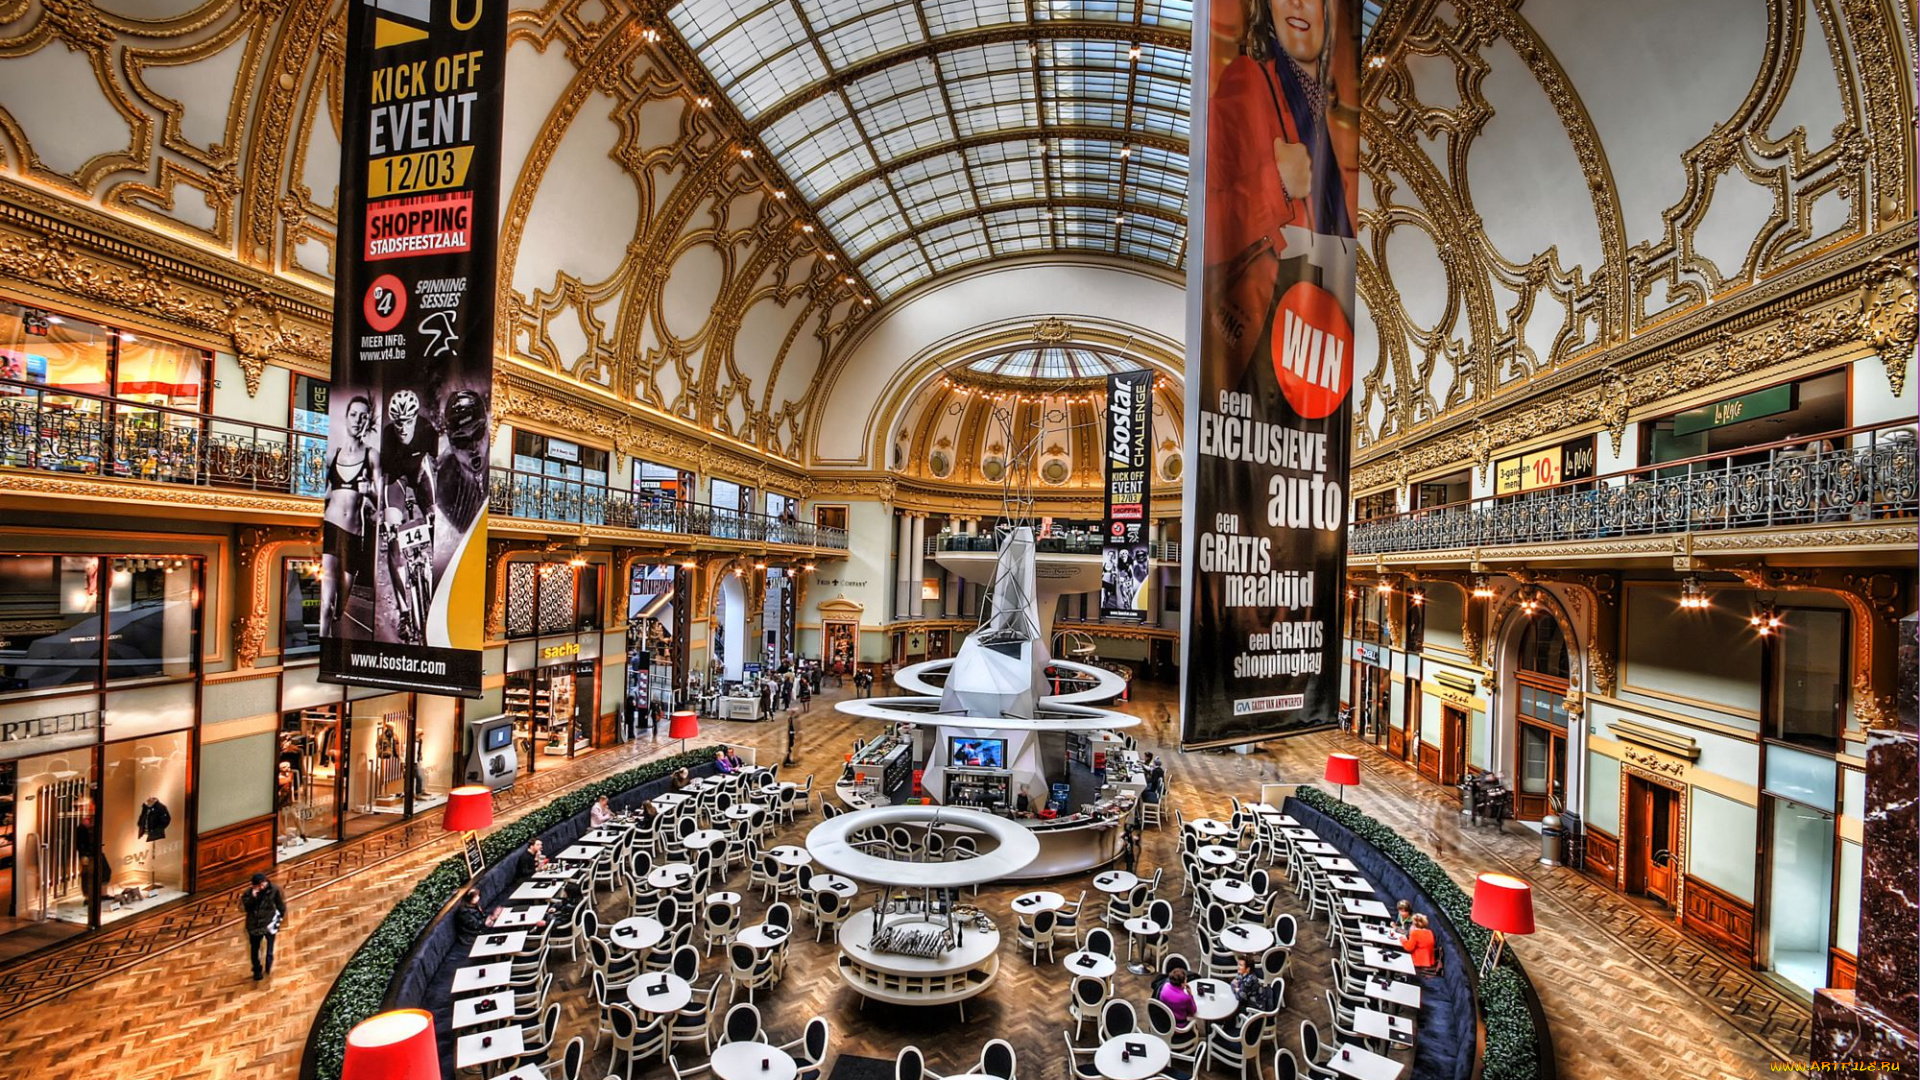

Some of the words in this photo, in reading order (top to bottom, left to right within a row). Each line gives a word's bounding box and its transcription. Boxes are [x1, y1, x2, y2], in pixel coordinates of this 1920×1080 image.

[372, 60, 427, 104] KICK
[434, 50, 483, 93] OFF
[370, 92, 478, 155] EVENT
[385, 151, 455, 192] 12/03
[371, 206, 467, 239] SHOPPING
[370, 231, 466, 255] STADSFEESTZAAL
[377, 292, 393, 314] 4
[420, 293, 461, 309] SESSIES
[360, 347, 406, 361] www.vt4.be
[361, 335, 383, 348] MEER
[385, 334, 406, 347] INFO:
[1282, 308, 1344, 394] WIN
[1219, 389, 1253, 418] een
[1108, 378, 1132, 464] isostar
[1134, 384, 1147, 468] CHALLENGE
[1200, 410, 1327, 472] EXCLUSIEVE
[1112, 472, 1129, 481] KICK
[1130, 471, 1145, 481] OFF
[1112, 481, 1143, 494] EVENT
[1117, 494, 1137, 503] 12/03
[1267, 473, 1342, 532] auto
[405, 529, 422, 544] 14
[1216, 512, 1238, 534] een
[1200, 532, 1271, 574] GRATIS
[1225, 570, 1314, 611] maaltijd
[543, 641, 580, 659] sacha
[1249, 631, 1270, 651] een
[1271, 621, 1323, 650] GRATIS
[351, 652, 446, 675] www.isostar.com
[1234, 649, 1322, 678] shoppingbag
